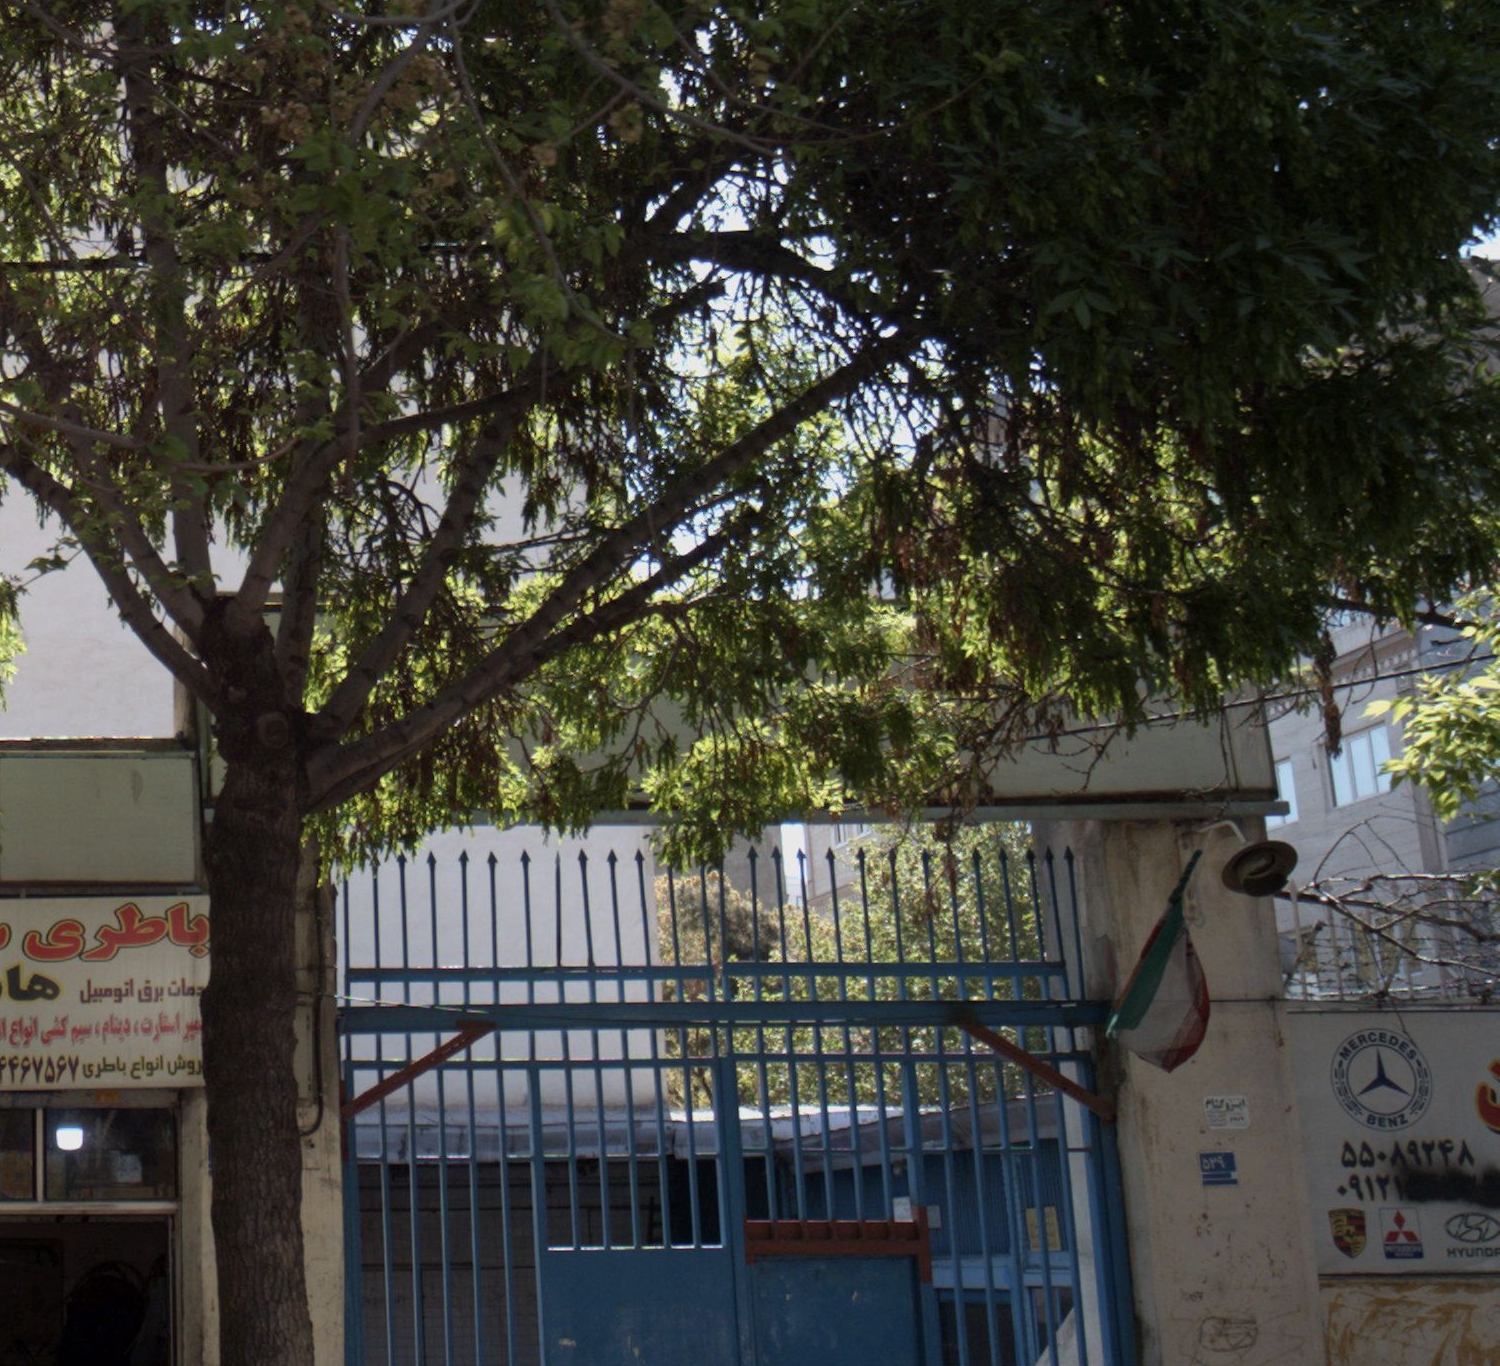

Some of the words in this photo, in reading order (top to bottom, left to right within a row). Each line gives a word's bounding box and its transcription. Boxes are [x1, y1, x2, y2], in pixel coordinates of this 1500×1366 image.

[23, 902, 209, 962] باطری
[80, 978, 134, 1004] اتومبیل
[138, 979, 164, 1003] برق
[167, 977, 204, 997] دمات
[9, 1014, 39, 1049] انواع
[1338, 1031, 1418, 1061] MERCEDES
[83, 1055, 126, 1079] باطری
[130, 1054, 163, 1080] انواع
[167, 1054, 203, 1076] روش
[1366, 1113, 1409, 1128] BENZ
